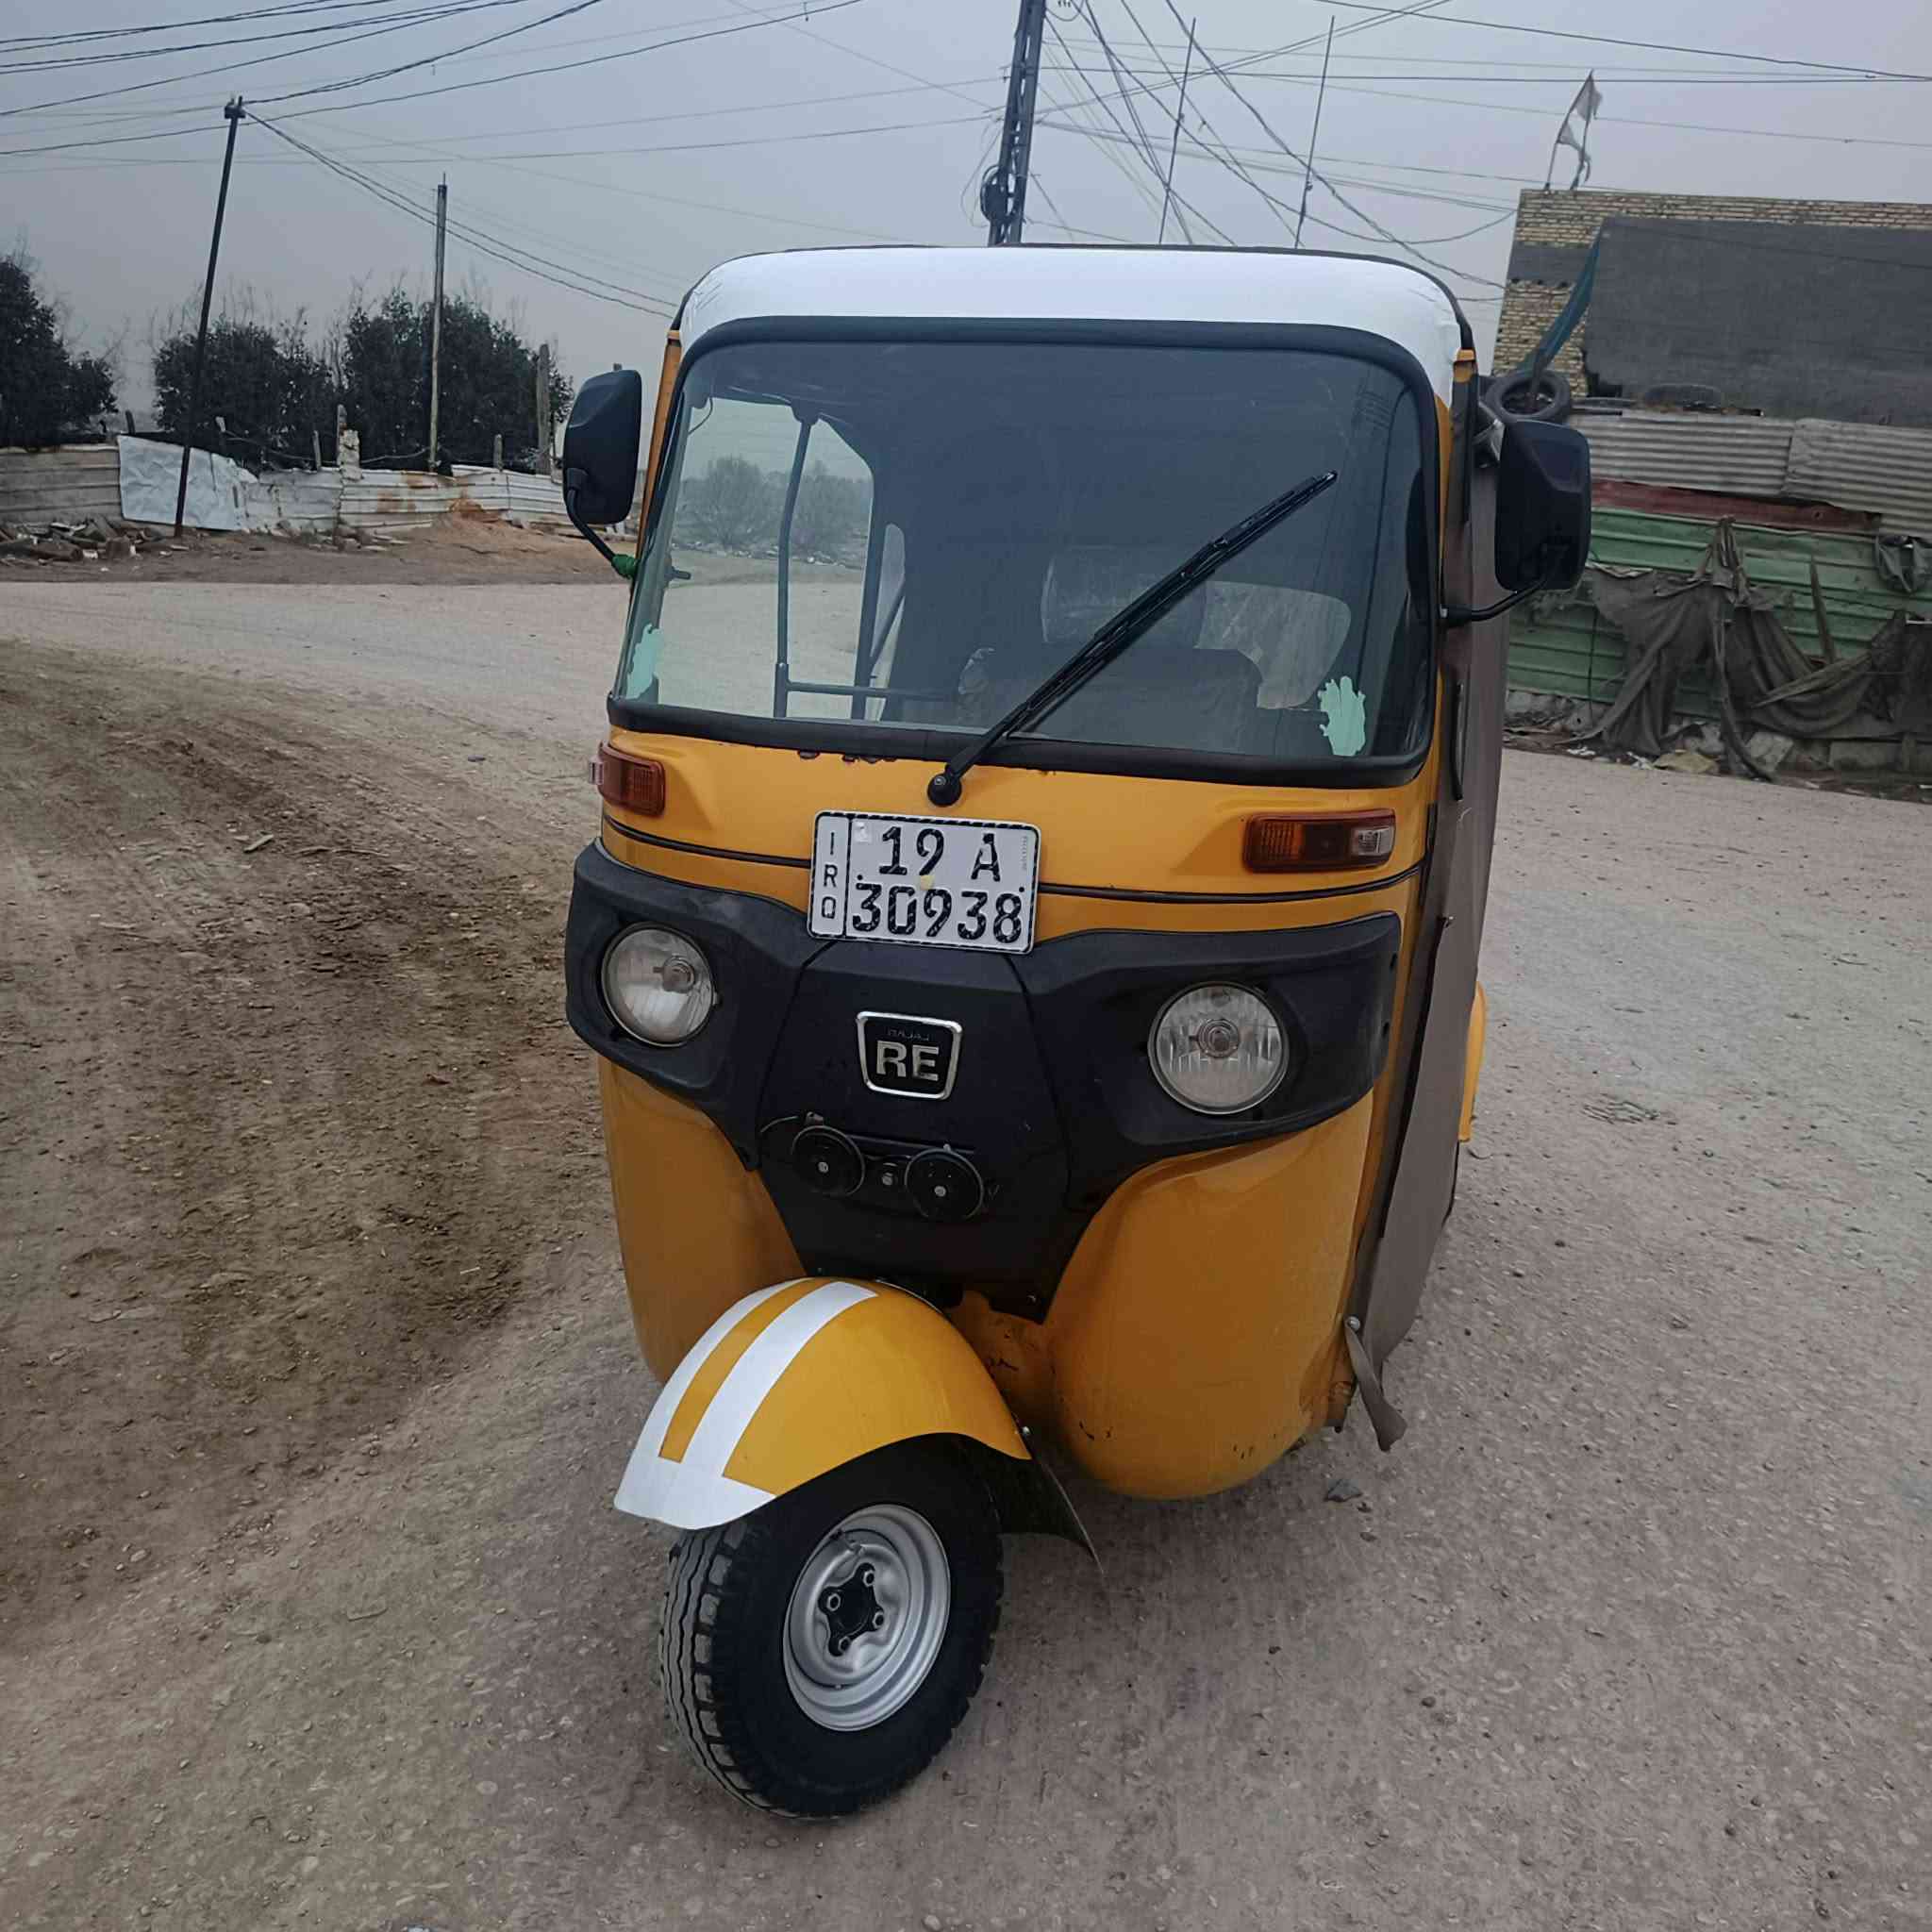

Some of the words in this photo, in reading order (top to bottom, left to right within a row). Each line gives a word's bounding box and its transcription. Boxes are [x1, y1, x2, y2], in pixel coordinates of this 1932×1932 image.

[878, 826, 944, 875] 19
[971, 833, 1000, 882] A
[852, 883, 1022, 943] 30938
[876, 1040, 940, 1081] RE
